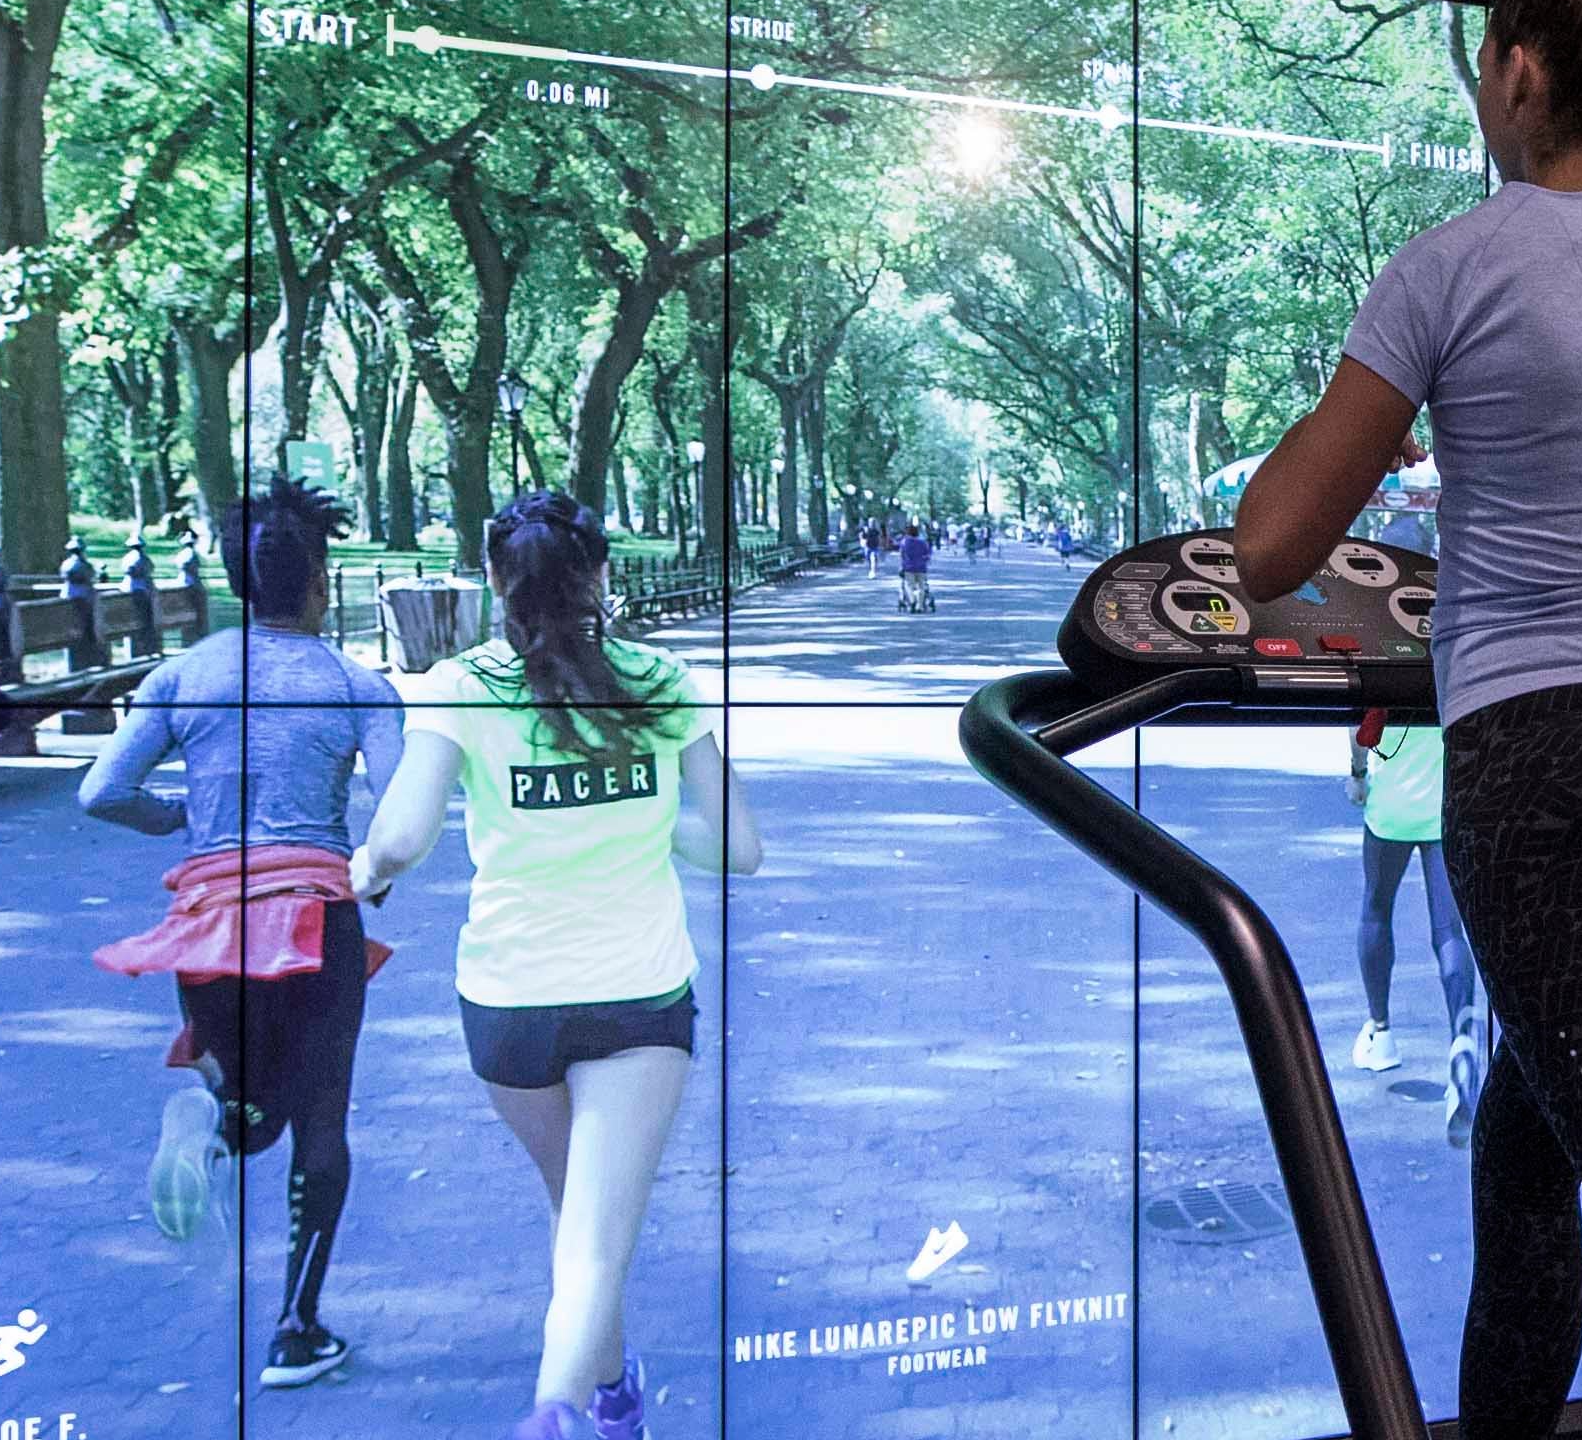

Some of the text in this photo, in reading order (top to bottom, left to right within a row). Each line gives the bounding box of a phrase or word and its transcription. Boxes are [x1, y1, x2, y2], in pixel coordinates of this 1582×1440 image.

[258, 8, 357, 50] START
[730, 16, 795, 42] STRIDE
[526, 79, 610, 108] 0.06 MI
[1410, 142, 1483, 173] FINISH
[1267, 643, 1288, 651] OFF
[515, 763, 649, 802] PACER
[735, 1293, 1128, 1362] NIKE LUNAREPIC LOW FLYKNIT
[888, 1346, 987, 1376] FOOTWEAR
